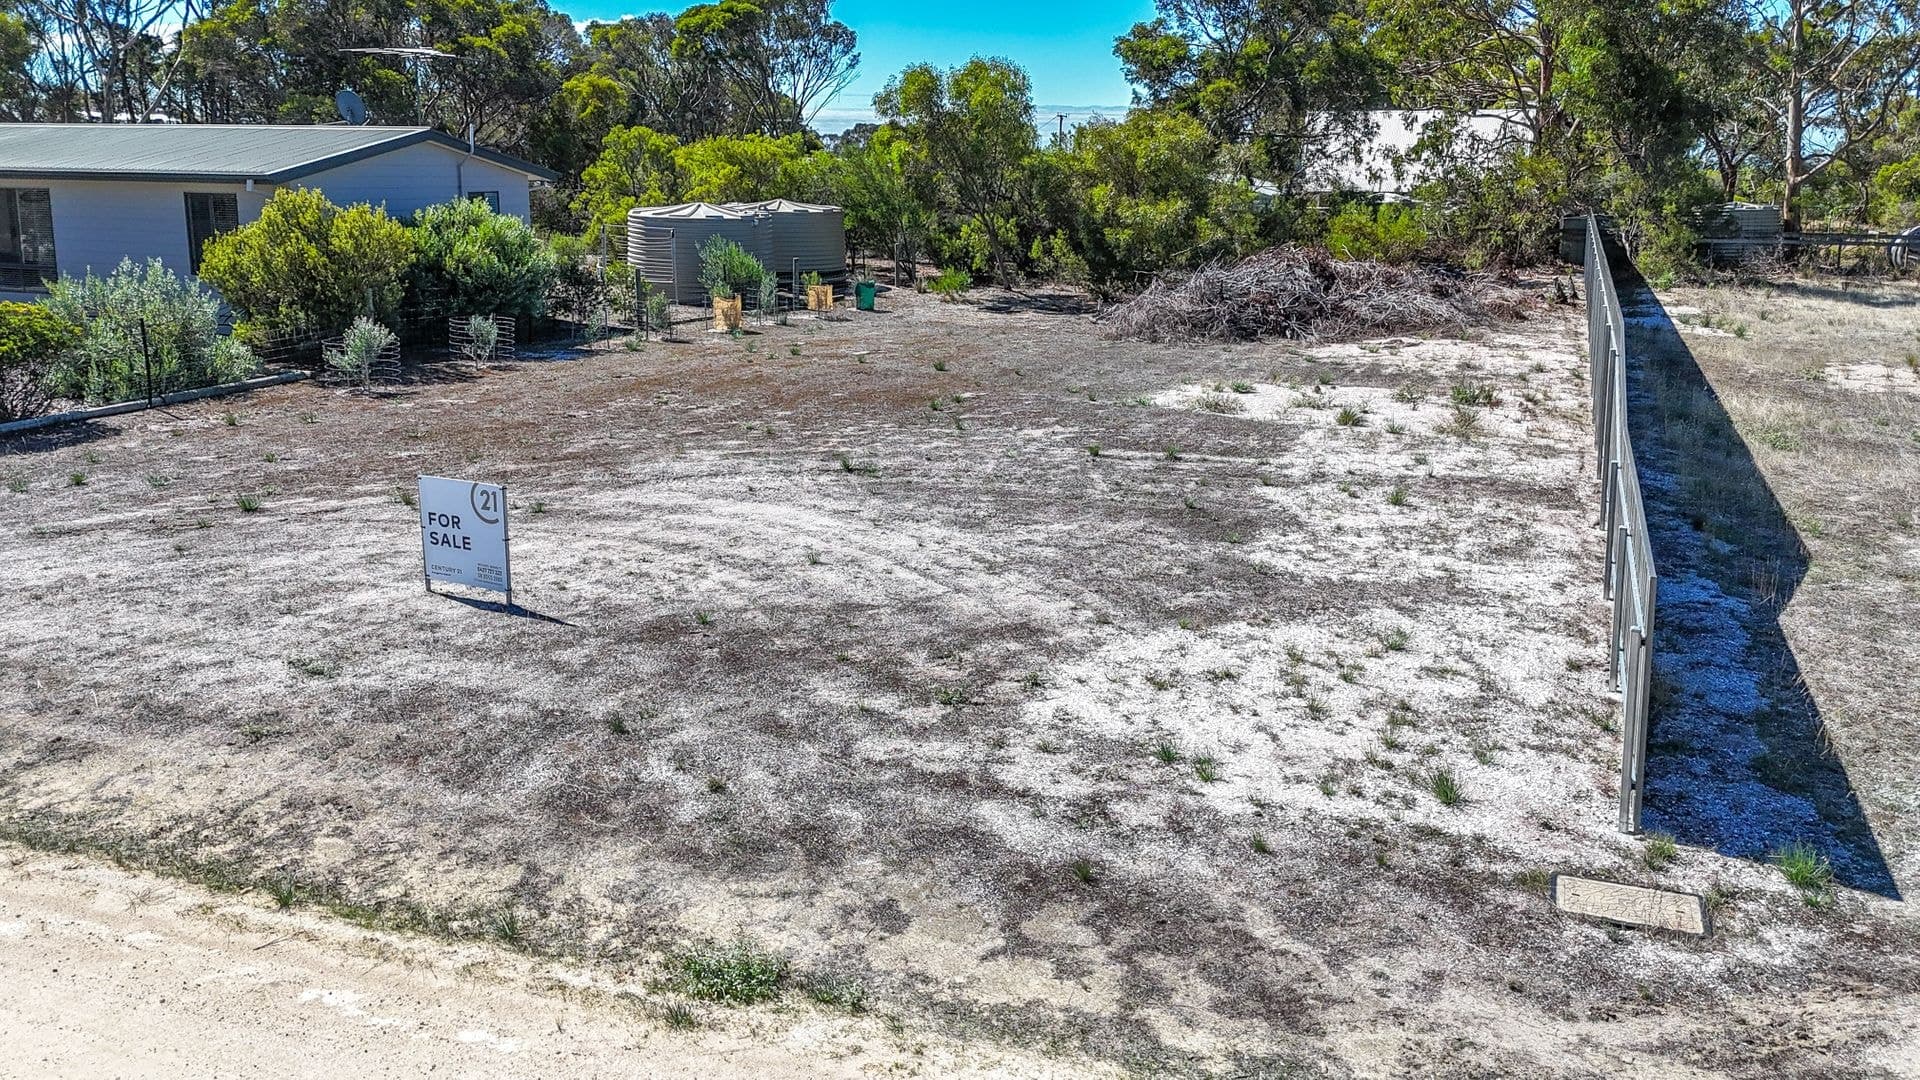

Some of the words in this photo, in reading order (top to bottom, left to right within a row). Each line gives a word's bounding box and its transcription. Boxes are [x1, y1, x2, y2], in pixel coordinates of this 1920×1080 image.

[479, 489, 498, 512] 21
[428, 512, 461, 530] FOR
[429, 531, 472, 551] SALE
